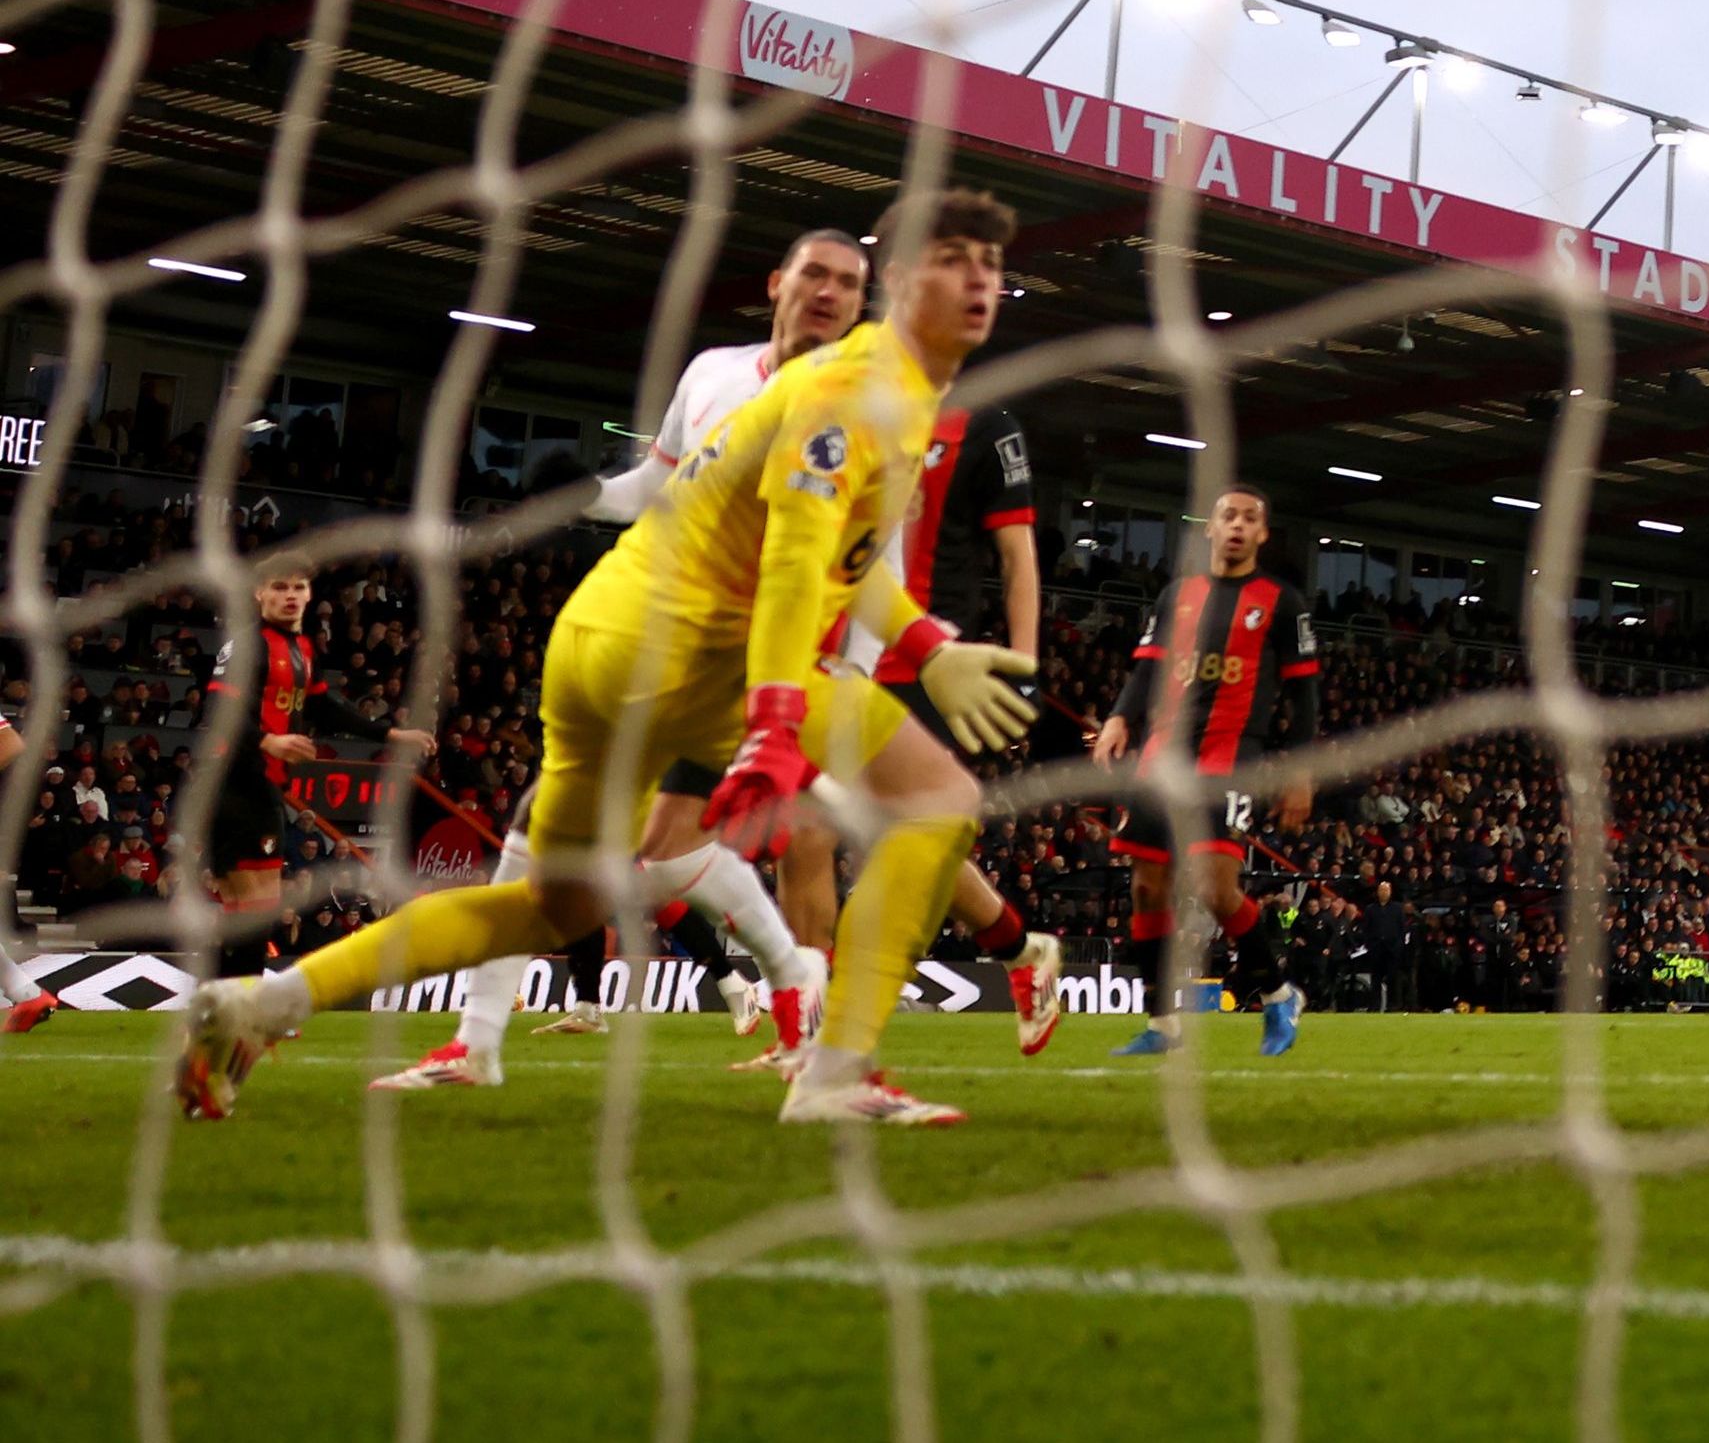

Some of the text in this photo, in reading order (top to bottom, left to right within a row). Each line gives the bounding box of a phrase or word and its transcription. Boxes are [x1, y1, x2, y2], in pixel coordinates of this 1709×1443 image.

[747, 10, 848, 98] Vitality
[1042, 86, 1443, 248] VITALITY
[0, 415, 47, 466] REE
[1225, 790, 1252, 832] 12
